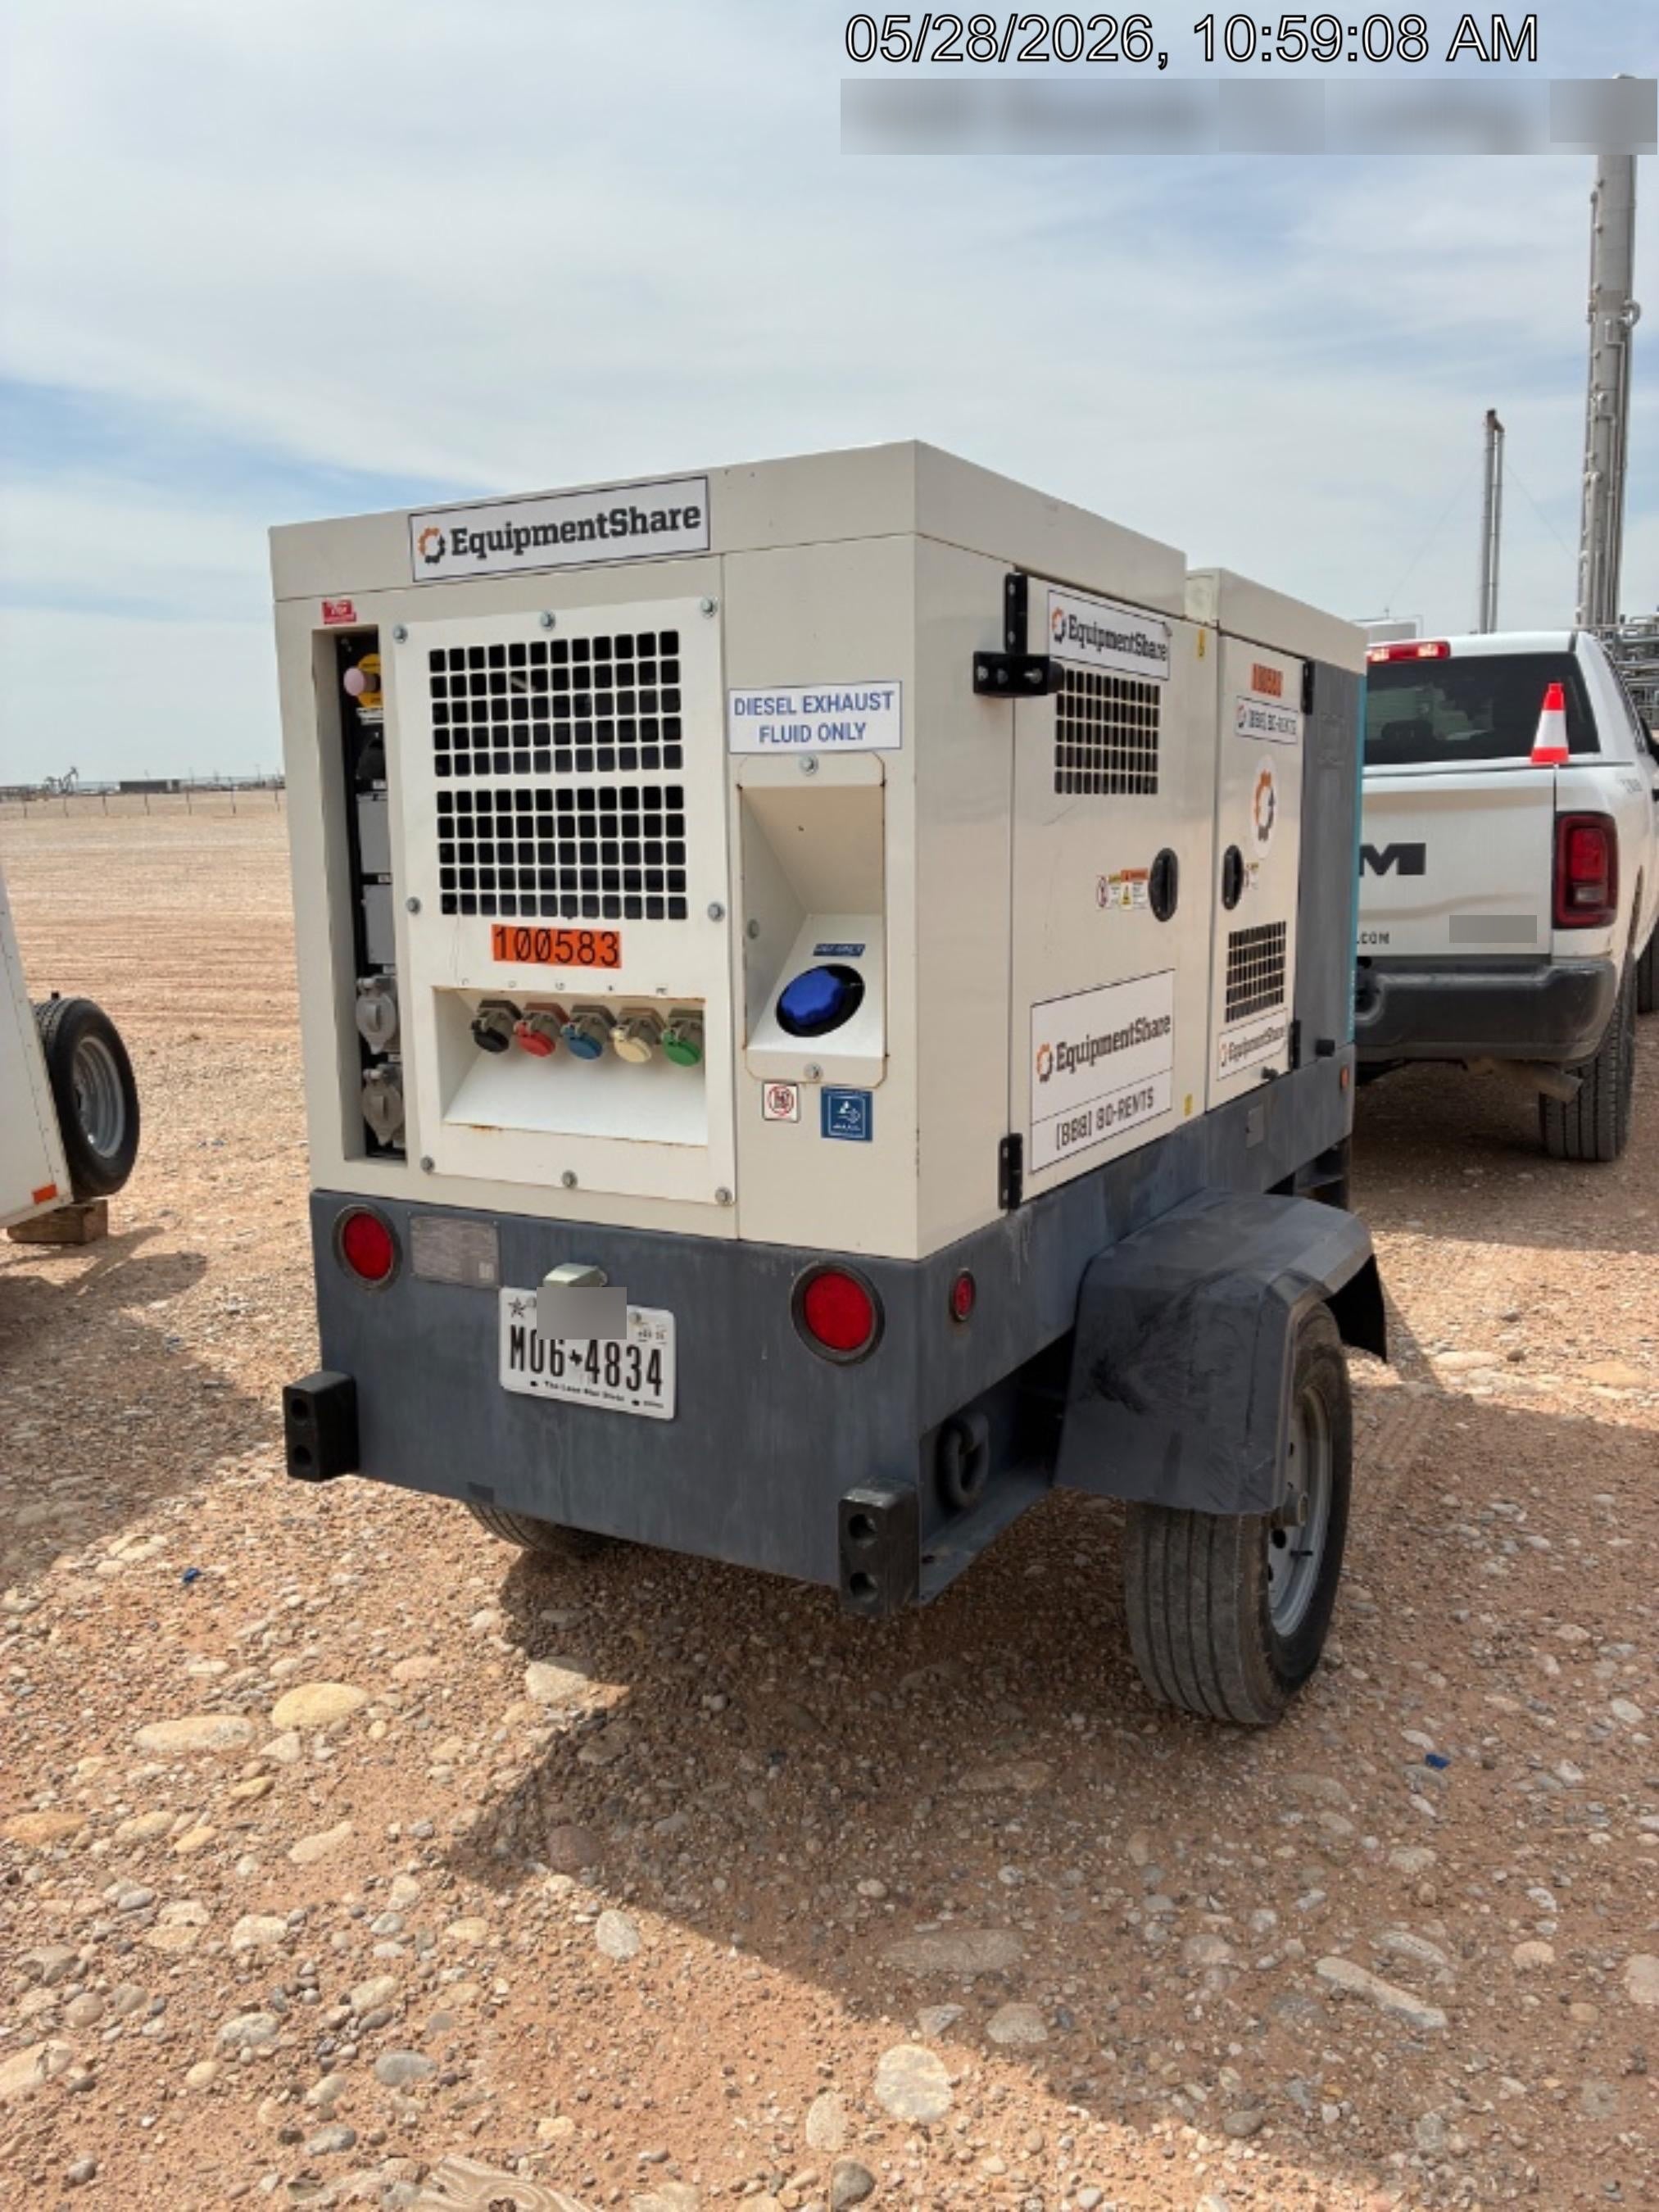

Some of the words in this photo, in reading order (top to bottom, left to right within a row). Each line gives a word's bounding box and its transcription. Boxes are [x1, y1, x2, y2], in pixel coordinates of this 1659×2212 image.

[450, 505, 701, 560] EquipmentShare
[1068, 614, 1167, 662] EquipmentShare
[734, 697, 797, 717] DIESEL
[803, 691, 895, 714] EXHAUST
[759, 724, 812, 744] FLUID
[818, 722, 867, 742] ONLY
[494, 925, 620, 967] 100583
[1056, 1015, 1172, 1074] EquipmentShare
[1095, 1086, 1154, 1131] 80-RENTS
